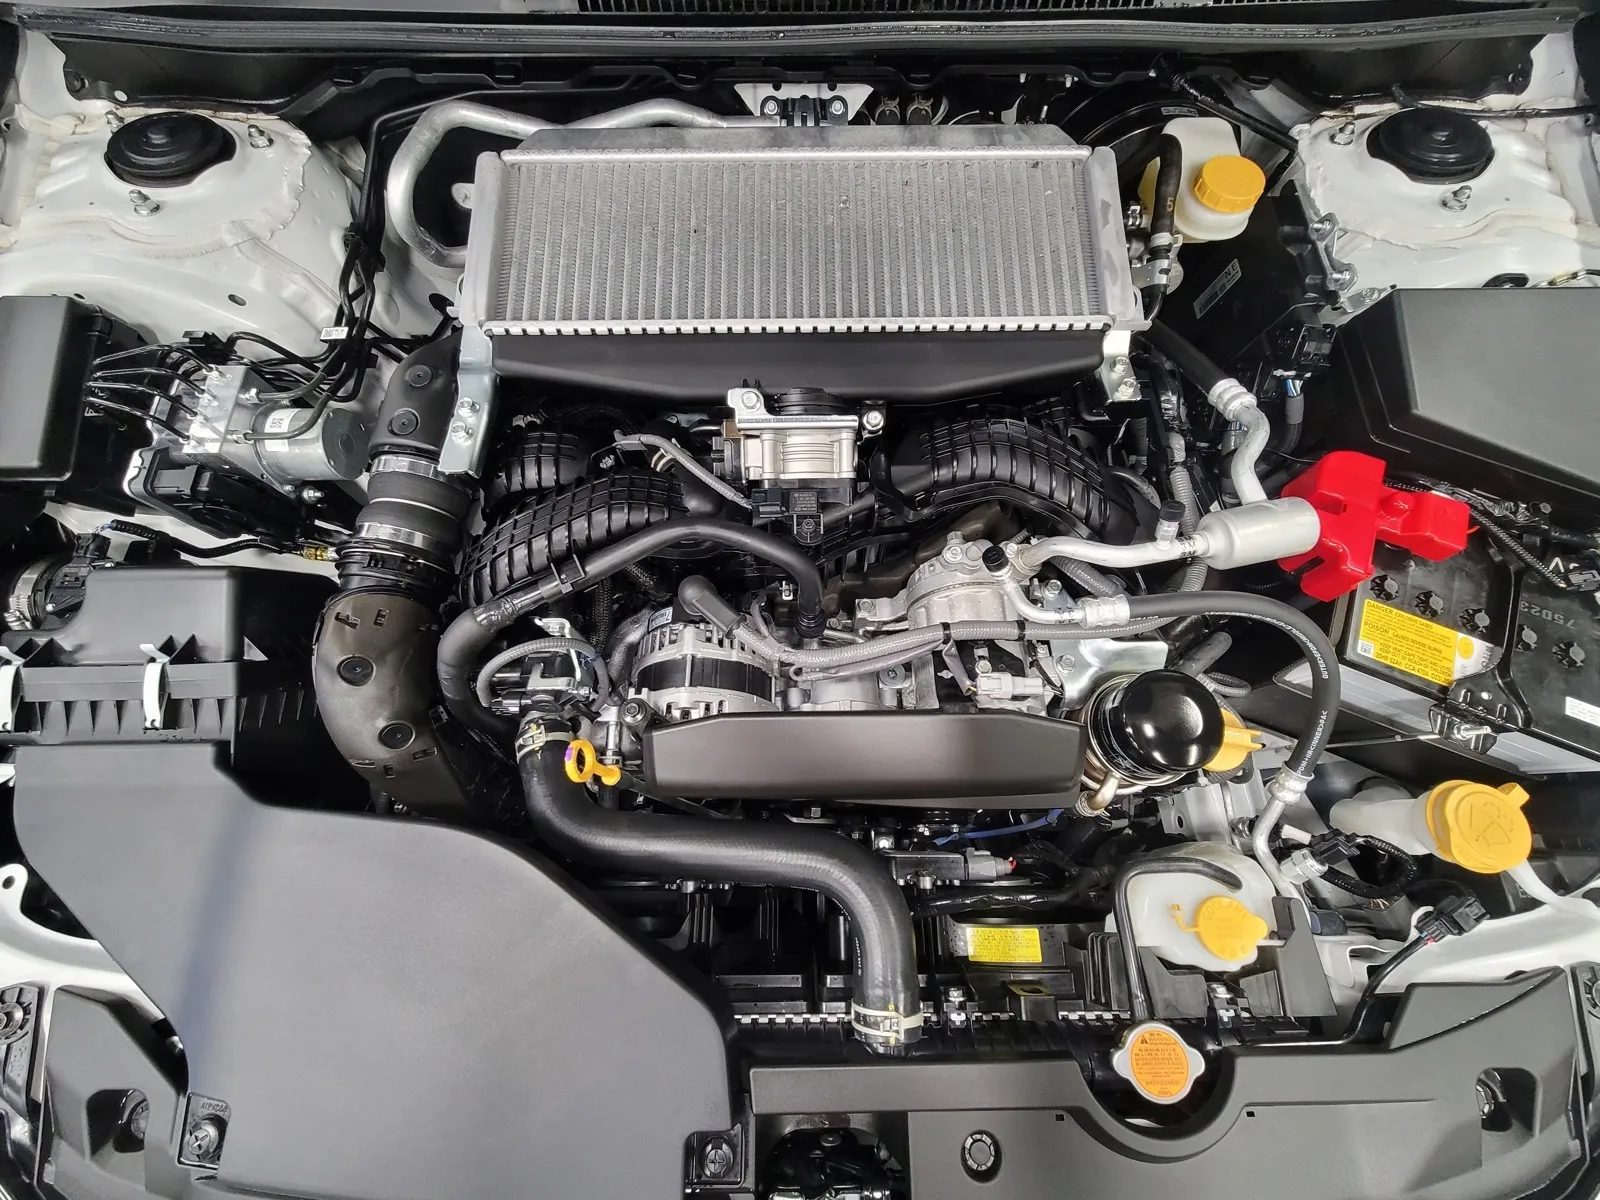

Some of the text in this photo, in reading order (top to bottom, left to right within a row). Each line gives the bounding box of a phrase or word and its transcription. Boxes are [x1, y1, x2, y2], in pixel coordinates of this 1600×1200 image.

[1366, 600, 1393, 615] DANGER
[1418, 620, 1433, 629] GASES
[1363, 620, 1389, 635] POISON
[1392, 631, 1409, 642] CAUSES
[1409, 637, 1427, 648] SEVERE
[1427, 644, 1442, 654] BURNS
[1379, 641, 1391, 649] KEEP
[1391, 645, 1403, 654] VENT
[1403, 649, 1415, 659] CAPS
[1416, 654, 1428, 664] TIGHT
[1429, 659, 1438, 667] AND
[1438, 663, 1452, 673] LEVEL
[1379, 646, 1390, 655] KEEP
[1391, 651, 1400, 659] OUT
[1407, 657, 1422, 667] REACH
[1429, 664, 1451, 678] CHILDREN
[1403, 662, 1416, 672] CCA
